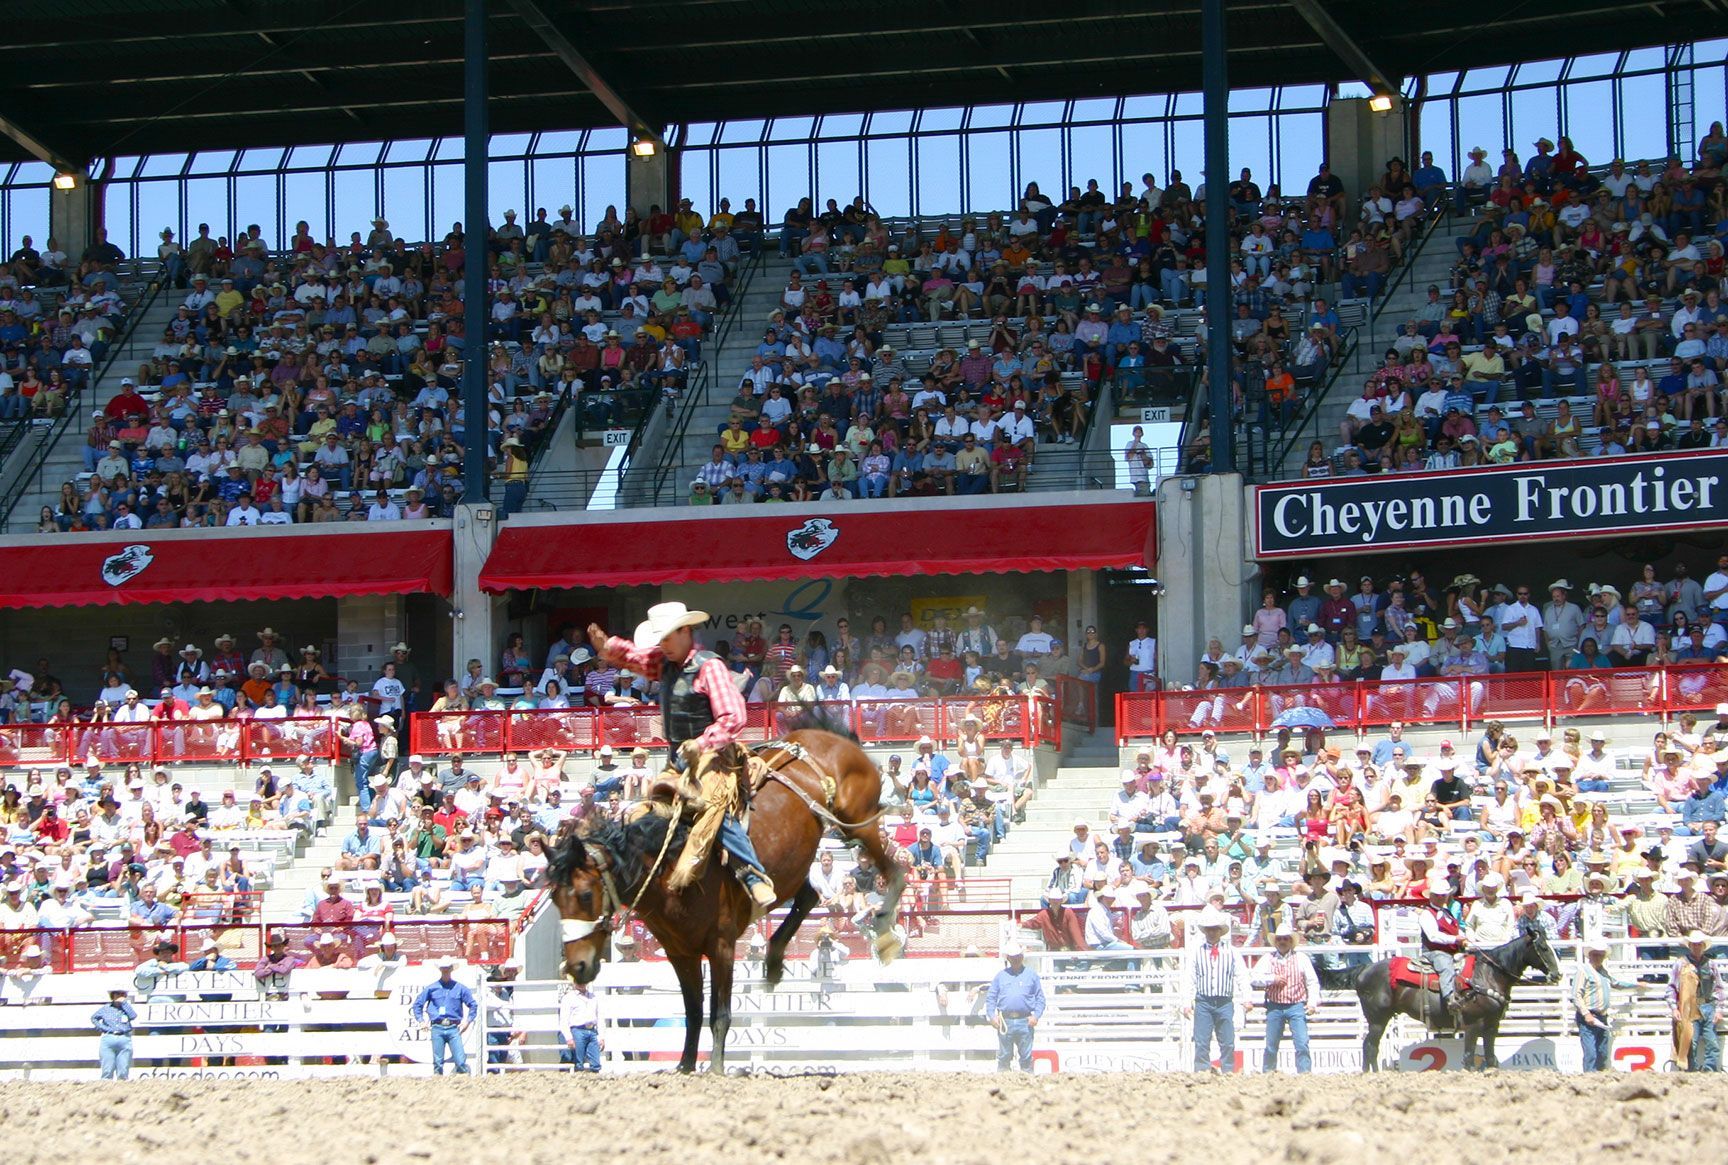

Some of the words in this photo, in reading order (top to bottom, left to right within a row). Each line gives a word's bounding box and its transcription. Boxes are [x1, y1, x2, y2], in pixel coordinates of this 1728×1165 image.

[1145, 410, 1166, 420] EXIT
[607, 433, 627, 444] EXIT
[1273, 491, 1491, 541] Cheyenne
[1513, 466, 1719, 522] Frontier
[703, 611, 767, 629] west
[133, 971, 287, 990] CHEYENNE
[147, 1002, 273, 1021] FRONTIER
[731, 994, 832, 1011] ONTIER
[180, 1035, 244, 1053] DAYS
[399, 1029, 432, 1042] AL
[725, 1027, 787, 1045] DAYS
[1408, 1046, 1448, 1072] 2
[1512, 1052, 1555, 1067] BANK
[1614, 1046, 1656, 1072] 3
[139, 1067, 280, 1080] cfdrodeocom
